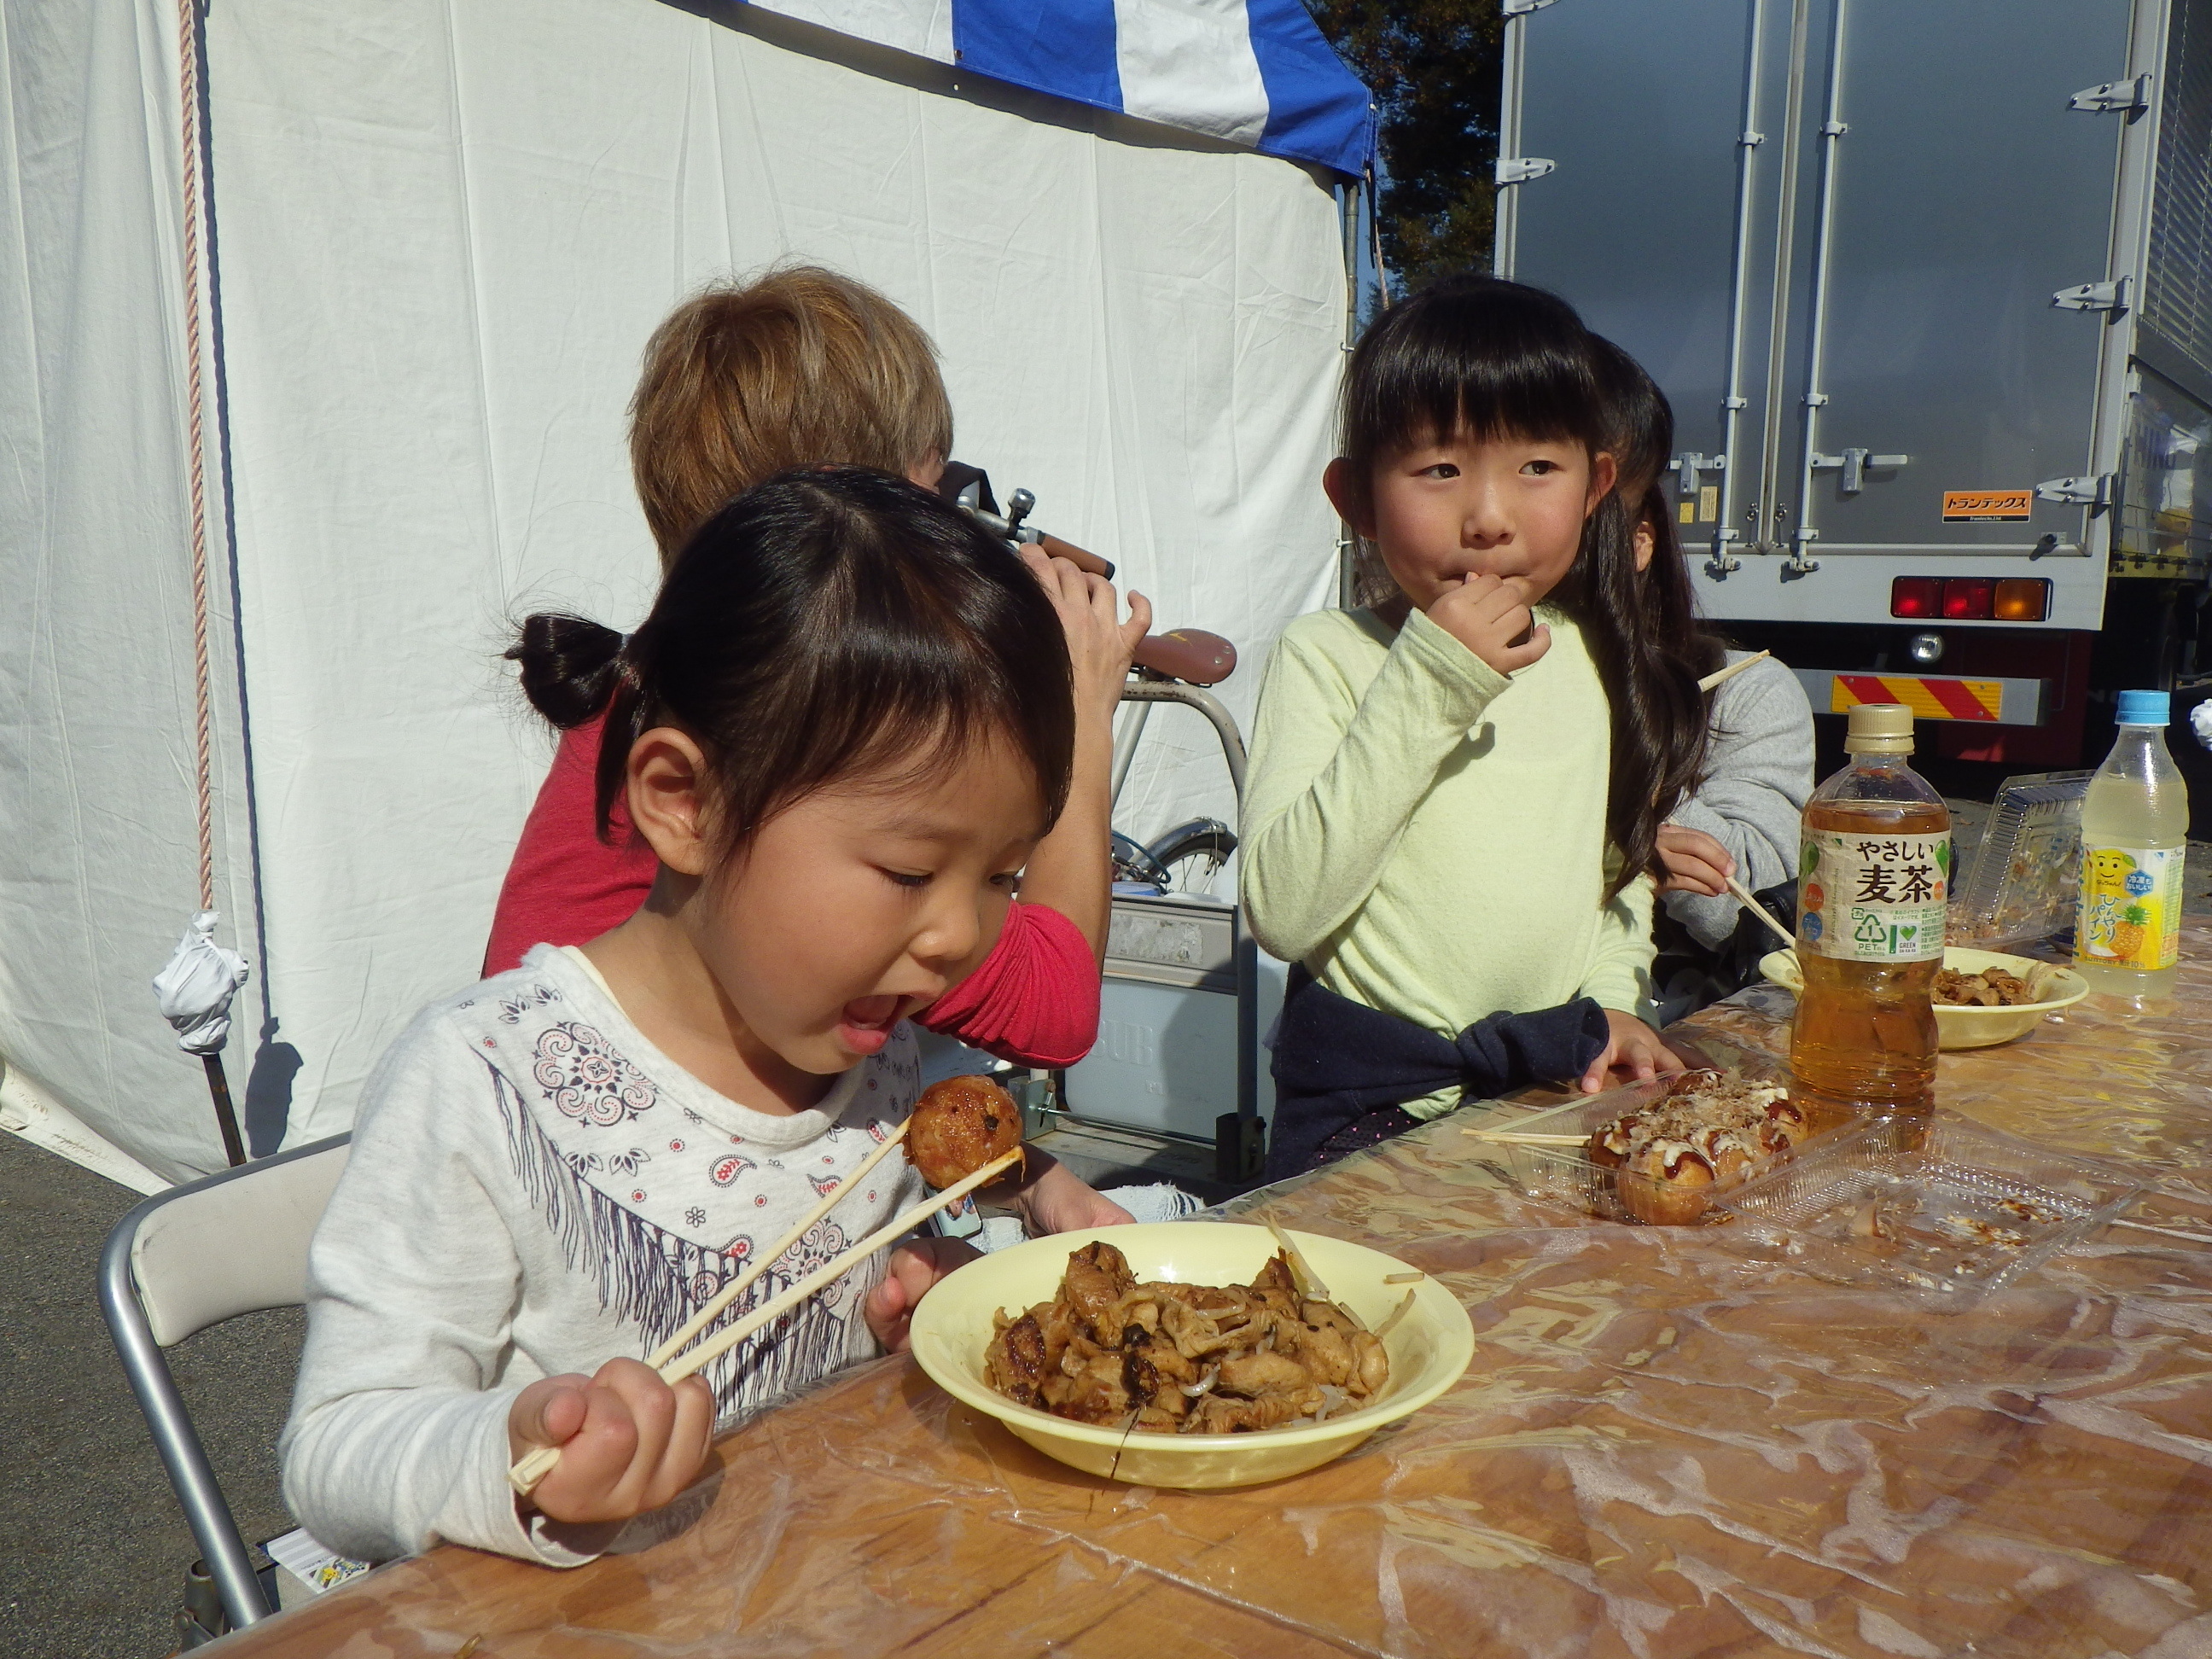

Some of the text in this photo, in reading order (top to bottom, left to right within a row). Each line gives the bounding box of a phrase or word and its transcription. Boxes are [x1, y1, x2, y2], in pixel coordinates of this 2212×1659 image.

[1947, 498, 2027, 509] トランテックス
[1856, 841, 1934, 862] やさしい
[1854, 864, 1933, 904] 麦茶
[1867, 924, 1872, 937] 1
[2089, 905, 2106, 940] パイン
[2099, 894, 2122, 944] ひんやり
